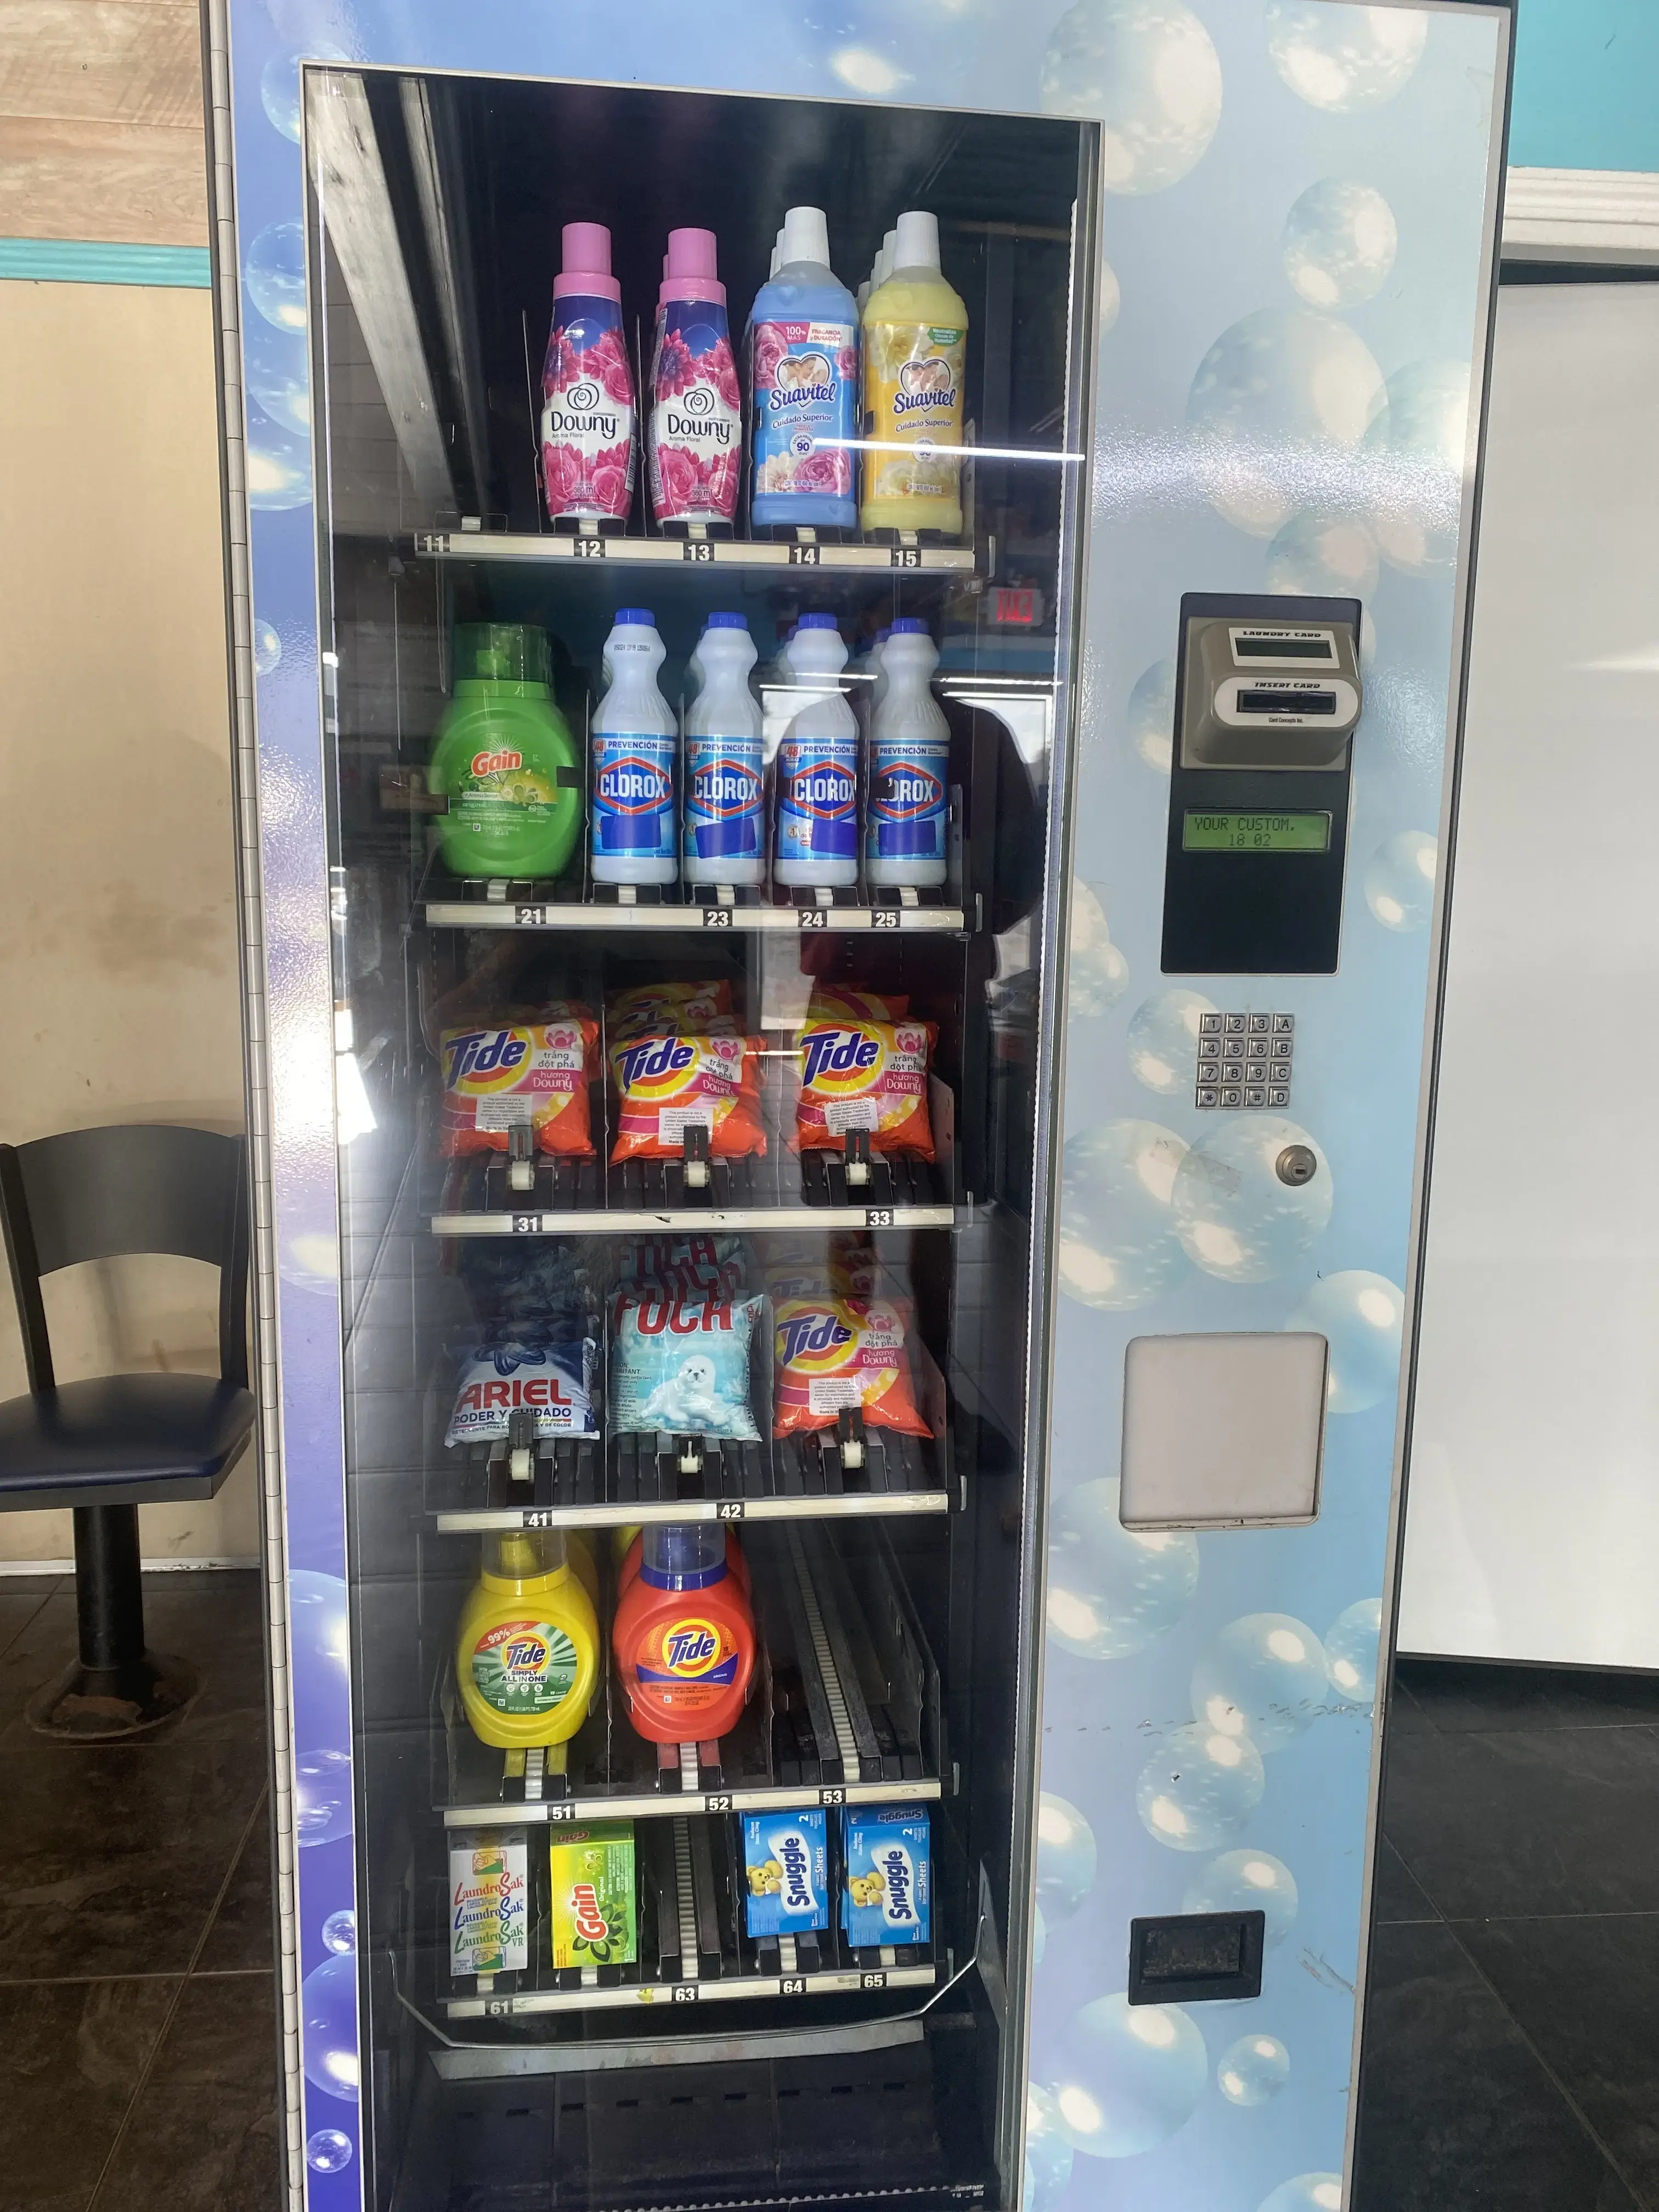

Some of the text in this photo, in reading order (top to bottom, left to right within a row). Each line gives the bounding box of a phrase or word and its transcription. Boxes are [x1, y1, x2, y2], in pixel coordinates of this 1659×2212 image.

[786, 326, 806, 336] 100%
[770, 382, 836, 410] Suavitel
[894, 388, 956, 414] Suavitel
[551, 411, 616, 439] Downy
[773, 414, 832, 428] Cuidado Superior
[896, 419, 953, 432] Cuidado Superior
[668, 414, 730, 444] Downy
[797, 442, 810, 452] 90
[424, 535, 444, 552] 11
[579, 540, 601, 558] 12
[688, 544, 710, 562] 13
[794, 548, 816, 565] 14
[896, 550, 917, 567] 15
[595, 740, 604, 752] 48
[608, 741, 658, 749] PREVENCIÓN
[688, 743, 698, 755] 48
[702, 743, 751, 753] PREVENCIÓN
[787, 746, 799, 757] 48
[804, 744, 850, 754] PREVENCIÓN
[879, 746, 927, 754] PREVENCIÓN
[471, 749, 522, 777] Gain
[600, 774, 665, 799] CLOROX
[694, 775, 758, 800] CLOROX
[794, 778, 855, 802] CLOROX
[876, 777, 934, 802] OROX
[1195, 817, 1295, 831] YOUR CUSTOM.
[1229, 833, 1271, 847] 18 02
[521, 909, 541, 924] 21
[707, 912, 729, 926] 23
[802, 912, 823, 927] 24
[876, 912, 897, 927] 25
[1211, 1019, 1289, 1029] 1 2 3 A
[544, 1049, 569, 1060] trắng
[1208, 1044, 1288, 1053] 4 5 6 B
[444, 1031, 527, 1092] Tide
[538, 1059, 574, 1069] đột phá
[614, 1037, 694, 1091] Tide
[799, 1031, 879, 1090] Tide
[890, 1063, 905, 1072] đột
[540, 1070, 570, 1080] hương
[719, 1070, 733, 1080] phá
[893, 1073, 919, 1084] hương
[1207, 1068, 1286, 1078] 7 8 9 C
[533, 1077, 573, 1091] Downy
[887, 1078, 921, 1094] Downy
[1229, 1093, 1285, 1102] 0 # D
[518, 1217, 538, 1232] 31
[870, 1211, 890, 1226] 33
[777, 1315, 852, 1366] Tide
[865, 1339, 898, 1348] đột phá
[869, 1332, 891, 1341] trắng
[869, 1349, 895, 1357] hương
[862, 1354, 898, 1367] Downy
[455, 1379, 572, 1414] ARIEL
[455, 1410, 495, 1425] PODER
[498, 1409, 508, 1419] Y
[720, 1504, 741, 1518] 42
[528, 1513, 547, 1527] 41
[487, 1628, 510, 1644] 99%
[506, 1643, 546, 1669] Tide
[668, 1632, 715, 1668] Tide
[708, 1798, 729, 1810] 52
[823, 1791, 843, 1804] 53
[552, 1807, 571, 1819] 51
[879, 1809, 922, 1822] Snuggle
[556, 1831, 590, 1843] Gain
[815, 1847, 823, 1873] Sheets
[779, 1837, 810, 1906] Snuggle
[918, 1860, 927, 1887] Sheets
[454, 1872, 524, 1906] LaundroSak
[882, 1850, 912, 1920] Snuggle
[454, 1896, 524, 1930] LaundroSak
[571, 1884, 608, 1941] Gain
[454, 1920, 524, 1955] LaundroSak
[511, 1937, 524, 1947] VR
[783, 1980, 803, 1993] 64
[864, 1975, 883, 1987] 65
[675, 1987, 695, 2001] 63
[490, 2001, 508, 2015] 61
